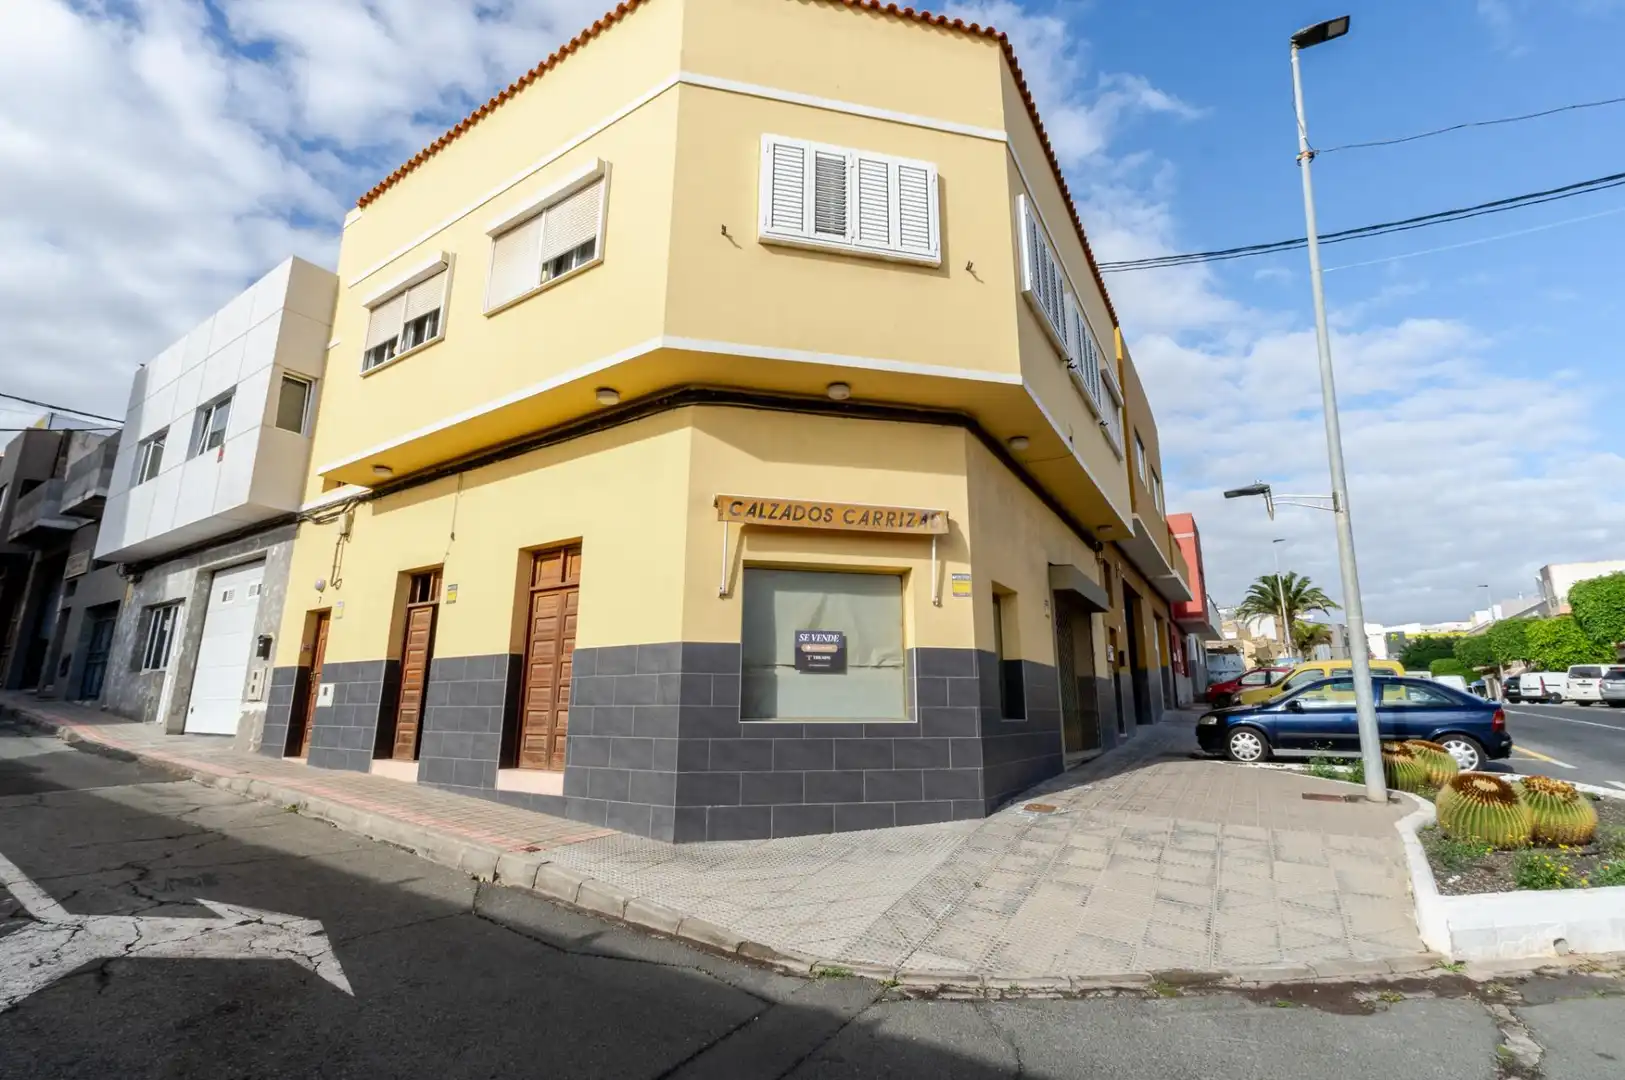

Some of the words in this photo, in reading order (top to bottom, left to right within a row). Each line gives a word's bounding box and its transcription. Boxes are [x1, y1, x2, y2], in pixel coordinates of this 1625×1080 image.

[729, 500, 834, 523] CALZADOS
[843, 508, 941, 530] CARRIZA
[798, 633, 810, 642] SE
[811, 633, 840, 643] VENDE
